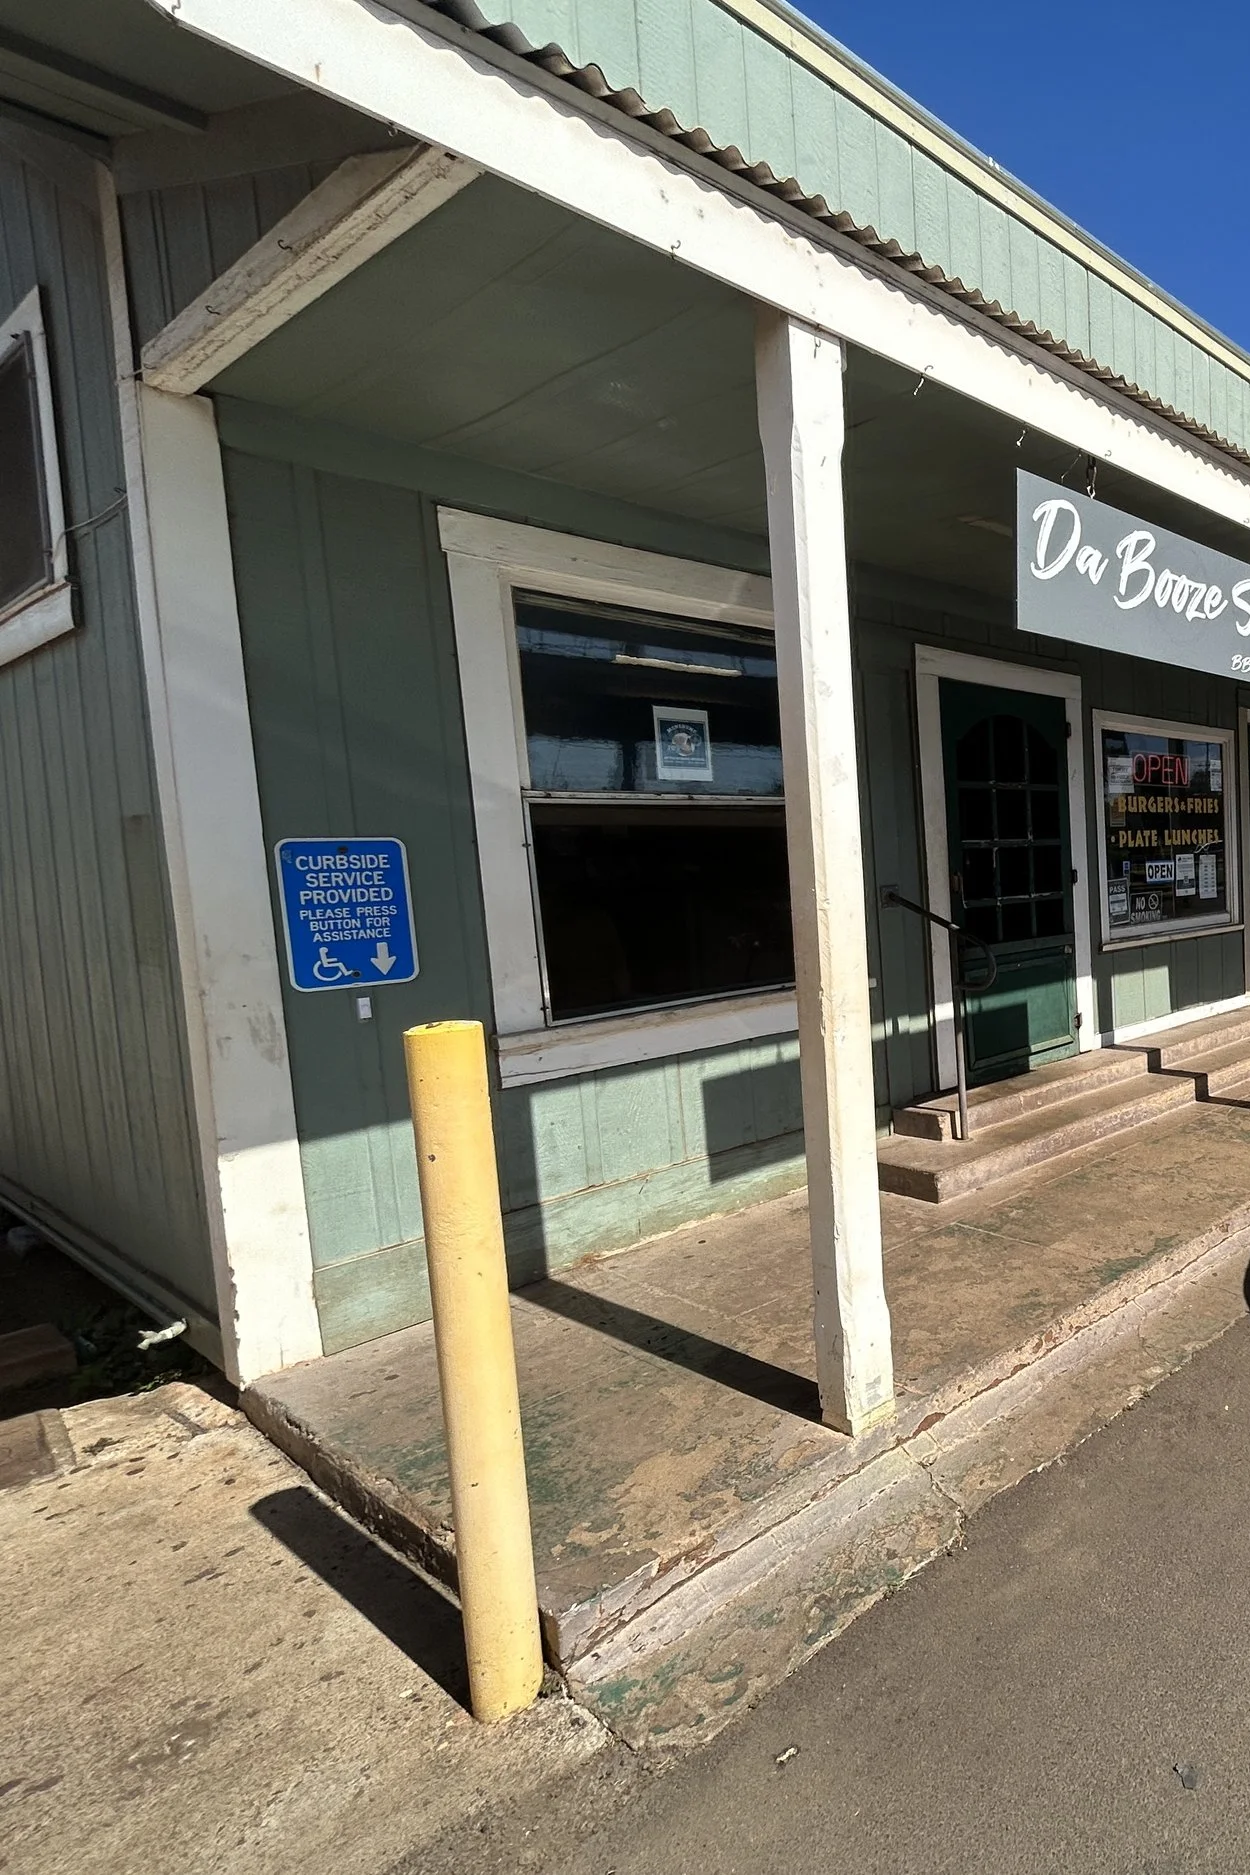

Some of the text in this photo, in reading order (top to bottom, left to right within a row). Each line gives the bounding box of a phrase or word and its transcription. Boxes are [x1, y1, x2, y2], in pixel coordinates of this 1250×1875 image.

[1030, 498, 1109, 586] Da
[1113, 529, 1229, 622] Booze
[1133, 753, 1189, 785] OPEN
[1118, 795, 1180, 814] BURGERS
[1187, 797, 1219, 814] FRIES
[1118, 829, 1219, 848] PLATE LUNCHES
[295, 854, 391, 871] CURBSIDE
[305, 871, 386, 888] SERVICE
[1147, 864, 1173, 880] OPEN
[299, 888, 394, 905] PROVIDED
[1109, 885, 1126, 894] PASS
[1135, 896, 1146, 910] NO
[299, 905, 398, 921] PLEASE PRESS
[1130, 909, 1161, 925] SMOKING
[309, 917, 391, 932] BUTTON FOR
[312, 928, 392, 943] ASSISTANCE
